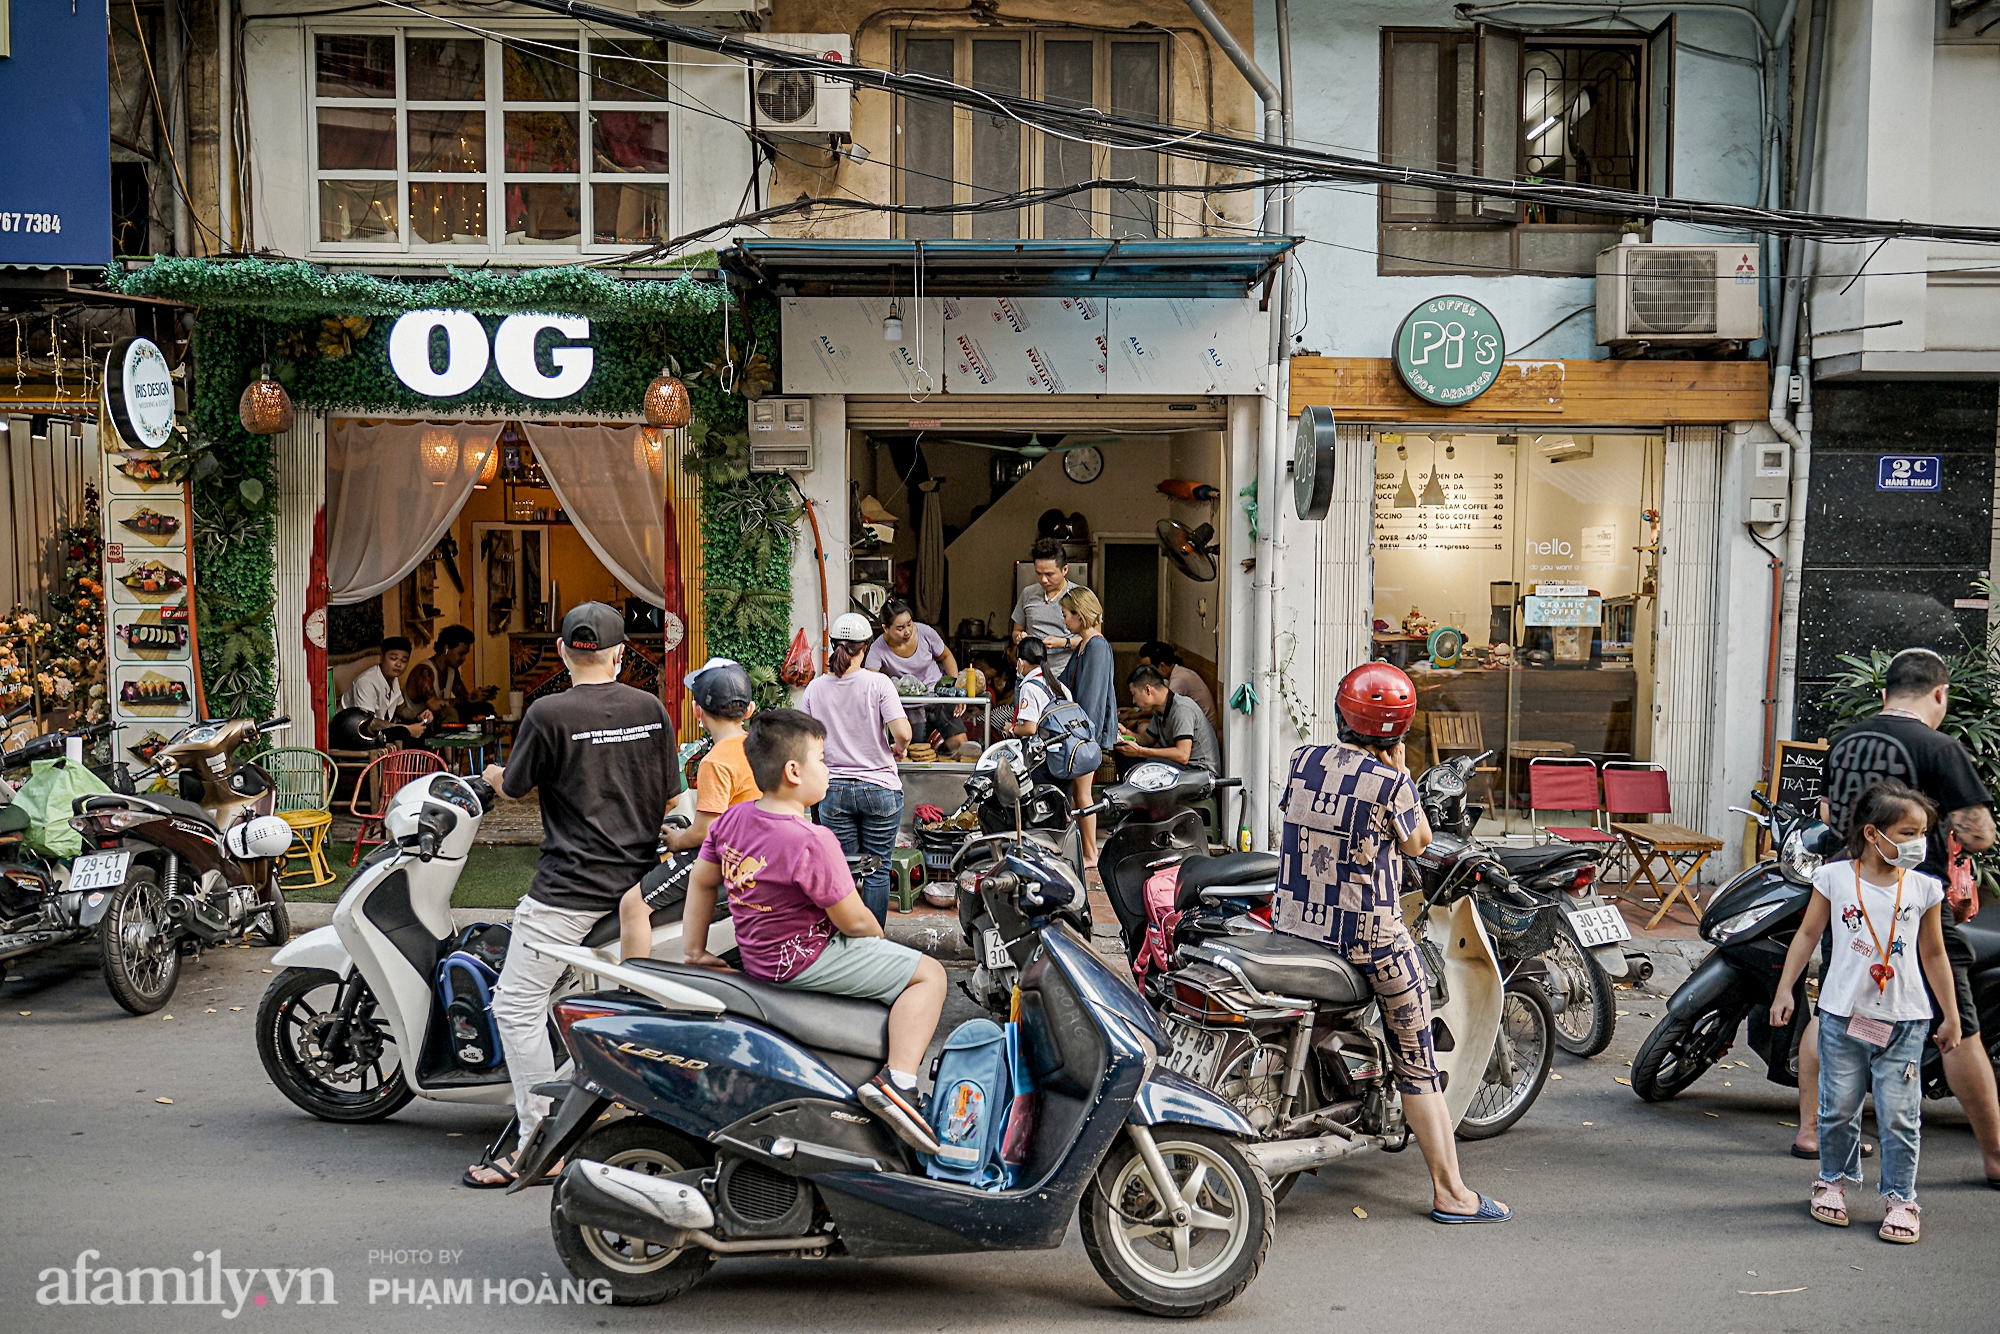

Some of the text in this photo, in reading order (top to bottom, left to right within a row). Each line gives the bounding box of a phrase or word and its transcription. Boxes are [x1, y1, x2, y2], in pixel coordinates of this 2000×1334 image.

[0, 212, 61, 234] 67 7384
[1428, 299, 1478, 317] COFFEE
[388, 308, 594, 399] OG
[956, 335, 988, 385] ALUTITAN
[134, 382, 170, 399] IRIS DESIGN
[1408, 368, 1492, 399] 100% ARABICA
[1910, 478, 1932, 486] THAN
[1526, 538, 1574, 559] hello,
[1540, 564, 1553, 572] you
[162, 610, 188, 618] LOHIP
[572, 641, 598, 649] KENZO
[1785, 753, 1824, 766] NEW
[1832, 738, 1907, 775] CHILL
[1782, 776, 1805, 792] TRÀ
[81, 854, 120, 873] 29-C1
[73, 869, 122, 889] 201.19
[1576, 909, 1614, 928] 30-L3
[1583, 924, 1622, 944] 8123
[1201, 942, 1231, 953] HONDA
[617, 1042, 709, 1070] LEAD
